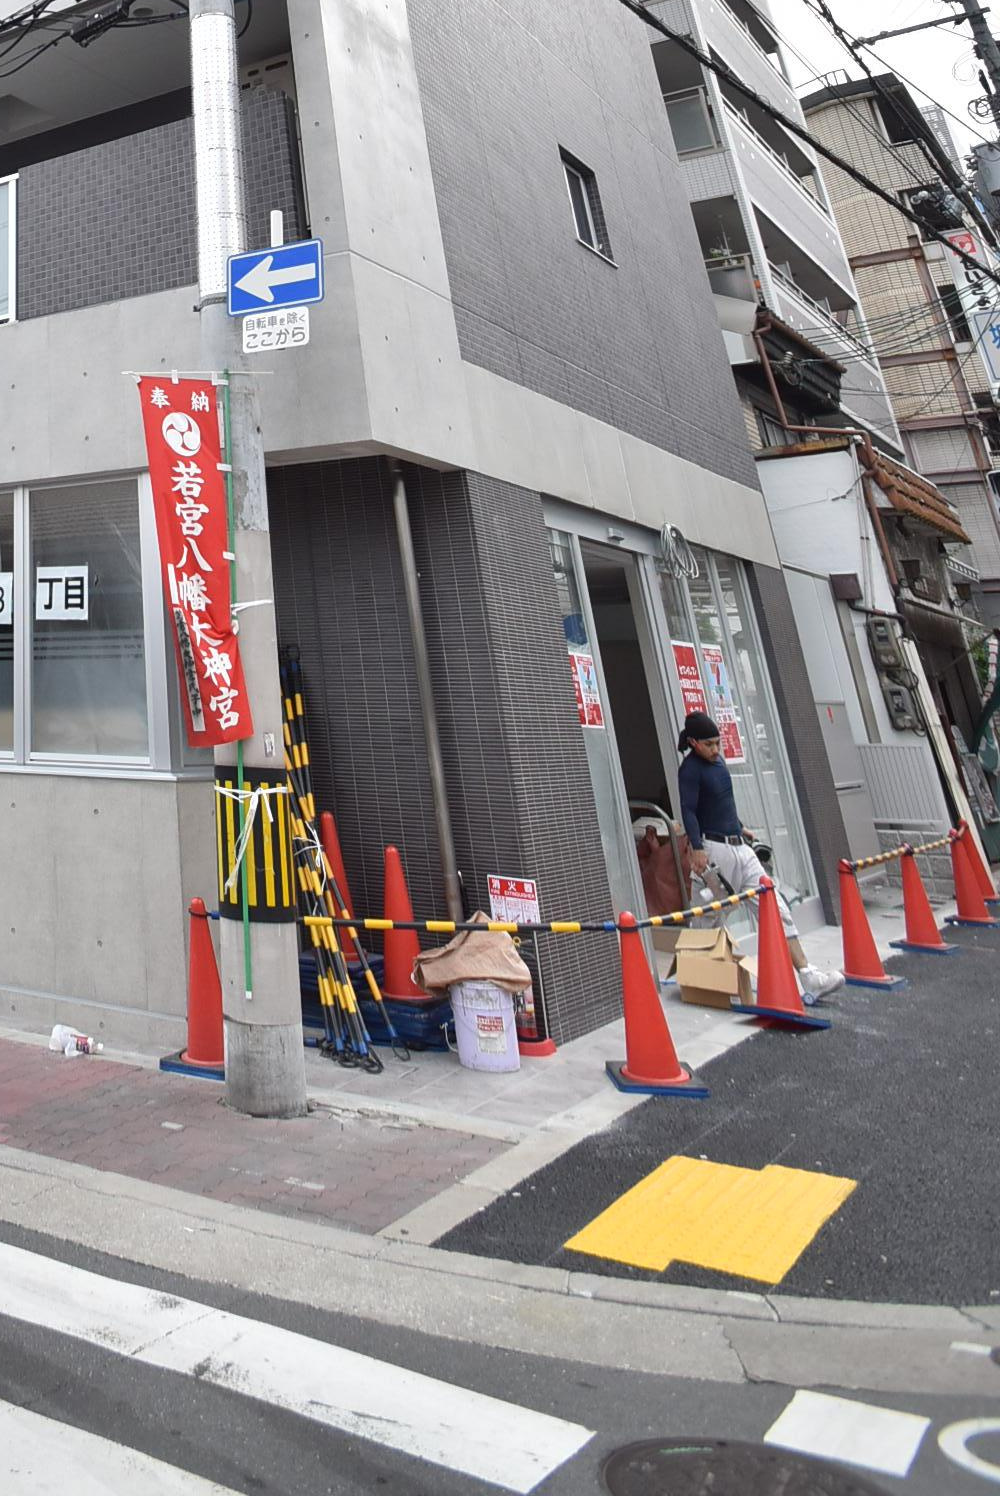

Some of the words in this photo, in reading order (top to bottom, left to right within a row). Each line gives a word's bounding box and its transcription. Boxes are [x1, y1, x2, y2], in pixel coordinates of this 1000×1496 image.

[246, 312, 306, 332] 自転車を除く
[246, 326, 306, 349] ここから
[170, 460, 241, 731] 若宮八幡大神宮
